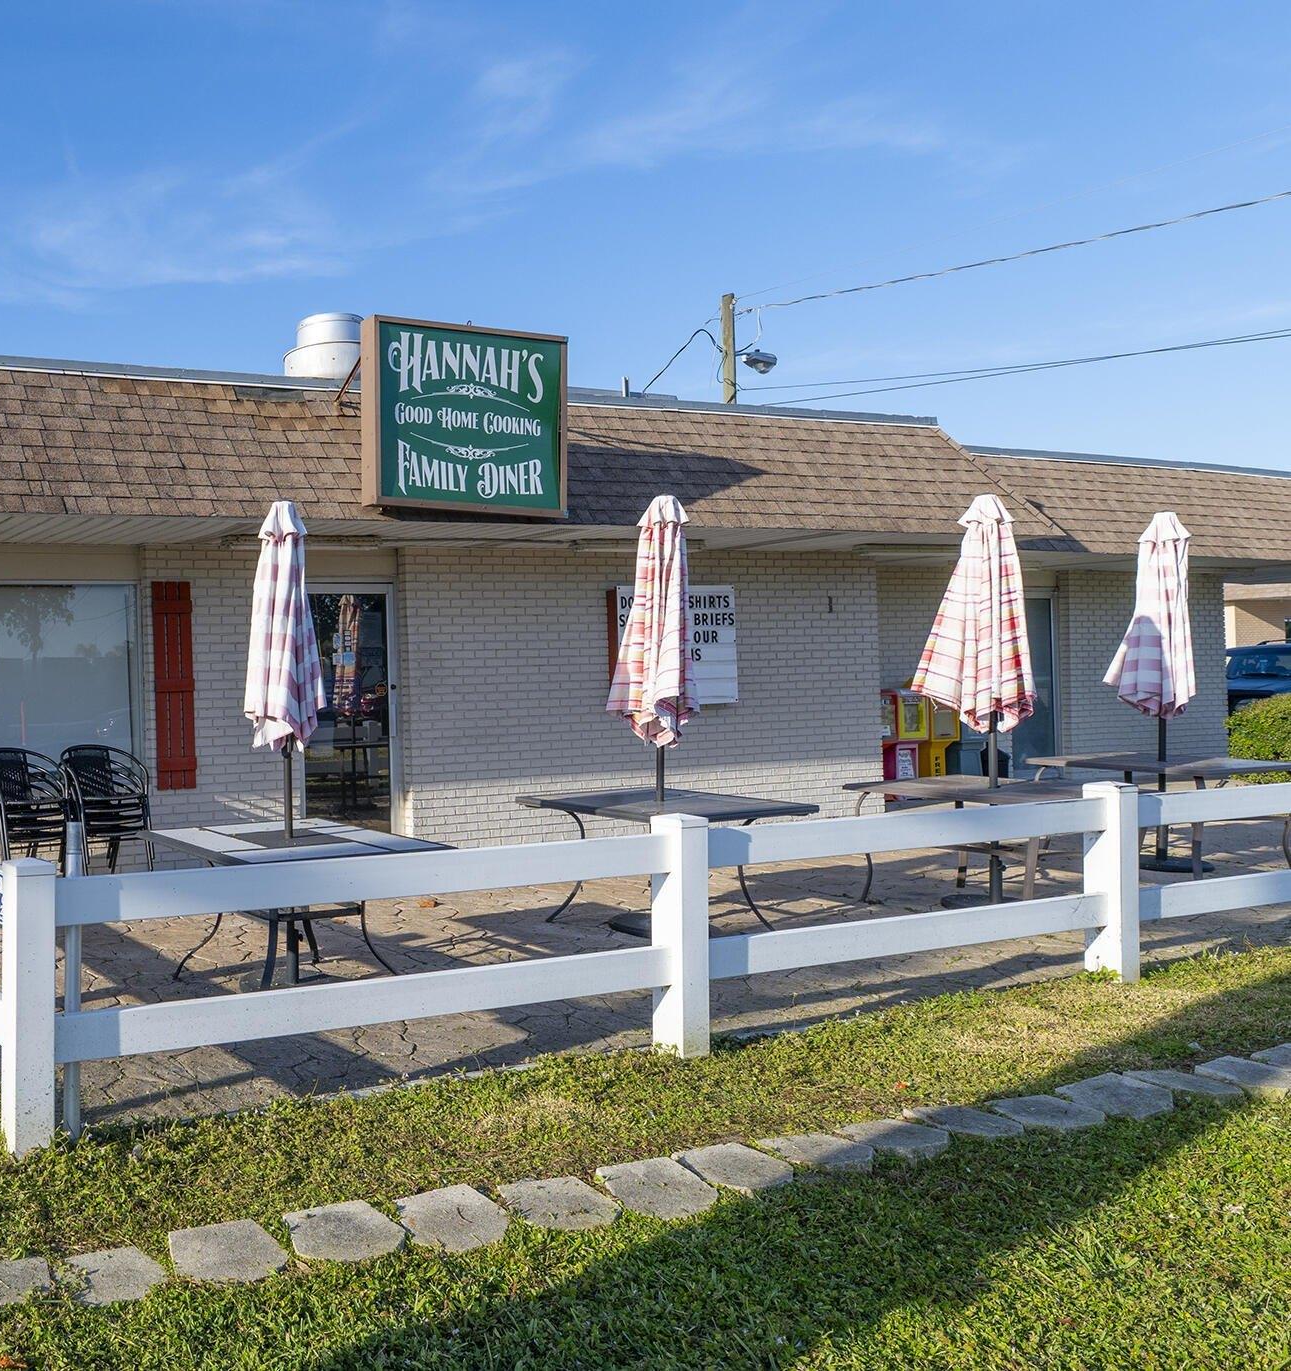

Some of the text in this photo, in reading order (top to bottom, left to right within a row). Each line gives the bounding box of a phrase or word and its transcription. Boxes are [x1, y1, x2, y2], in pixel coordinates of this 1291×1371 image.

[388, 331, 544, 404] HANNAH'S
[394, 402, 541, 437] GOOD HOME COOKING
[397, 439, 544, 499] FAMILY DINER
[693, 631, 718, 643] OUR
[694, 613, 735, 626] BRIEFS
